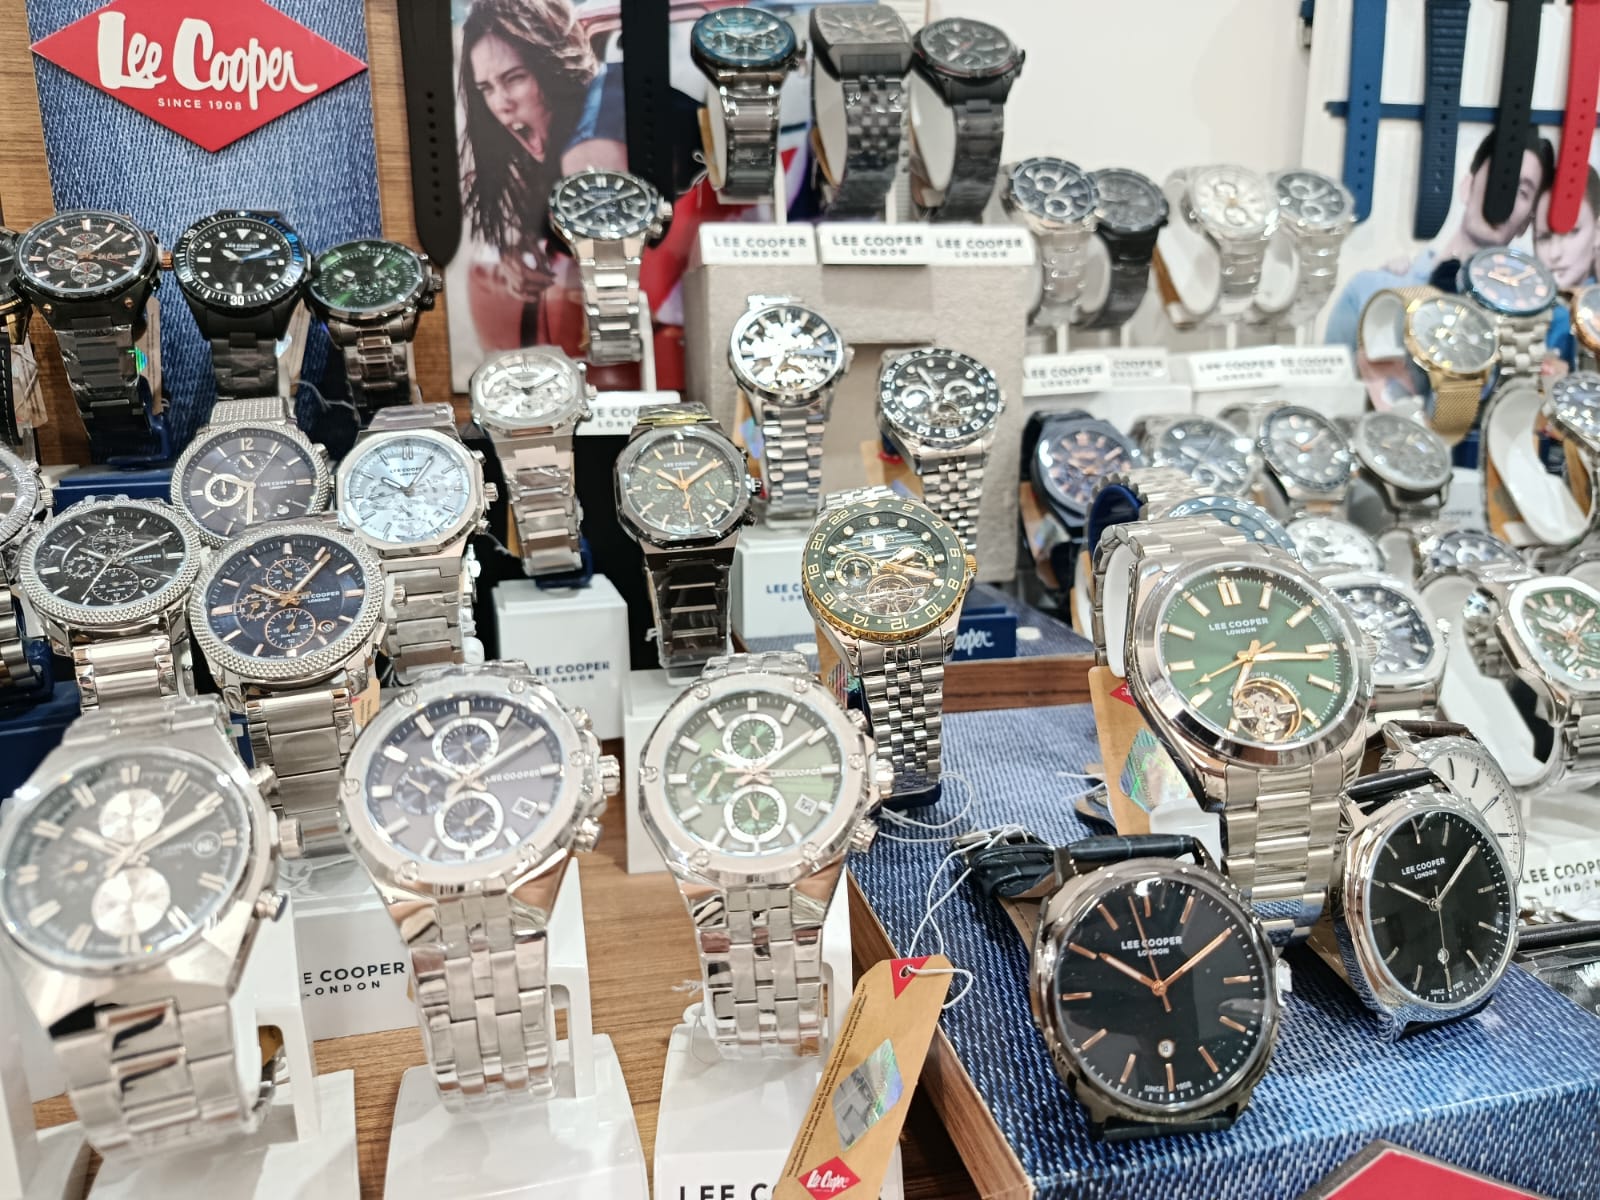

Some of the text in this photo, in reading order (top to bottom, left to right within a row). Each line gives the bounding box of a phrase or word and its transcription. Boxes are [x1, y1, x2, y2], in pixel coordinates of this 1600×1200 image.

[97, 11, 318, 111] Lee Cooper
[158, 97, 243, 111] SINCE 1908
[184, 229, 198, 239] 50
[832, 235, 923, 246] LEE COOPER
[713, 236, 807, 248] LEE COOPER
[936, 239, 1023, 249] LEE COOPER
[851, 248, 908, 256] LONDON
[230, 295, 245, 306] 30
[241, 438, 254, 451] 12
[902, 503, 915, 512] 2
[829, 510, 849, 525] 22
[931, 519, 944, 529] 4
[810, 533, 826, 550] 20
[807, 563, 821, 580] 18
[766, 584, 788, 594] LEE
[947, 578, 960, 590] 8
[311, 591, 341, 599] COOPER
[821, 593, 839, 610] 16
[925, 602, 943, 618] 10
[852, 612, 870, 627] 14
[890, 617, 910, 630] 12
[1208, 617, 1269, 631] LEE COOPER
[1226, 627, 1257, 636] LONDON
[954, 628, 995, 656] ooper
[535, 661, 610, 676] EE COOPER
[544, 673, 595, 684] LONDON
[1401, 857, 1446, 876] LEE COOPER
[1414, 869, 1437, 880] LONDON
[1121, 935, 1183, 950] LEE COOPER
[320, 962, 405, 982] COOPER
[306, 980, 380, 997] ONDON
